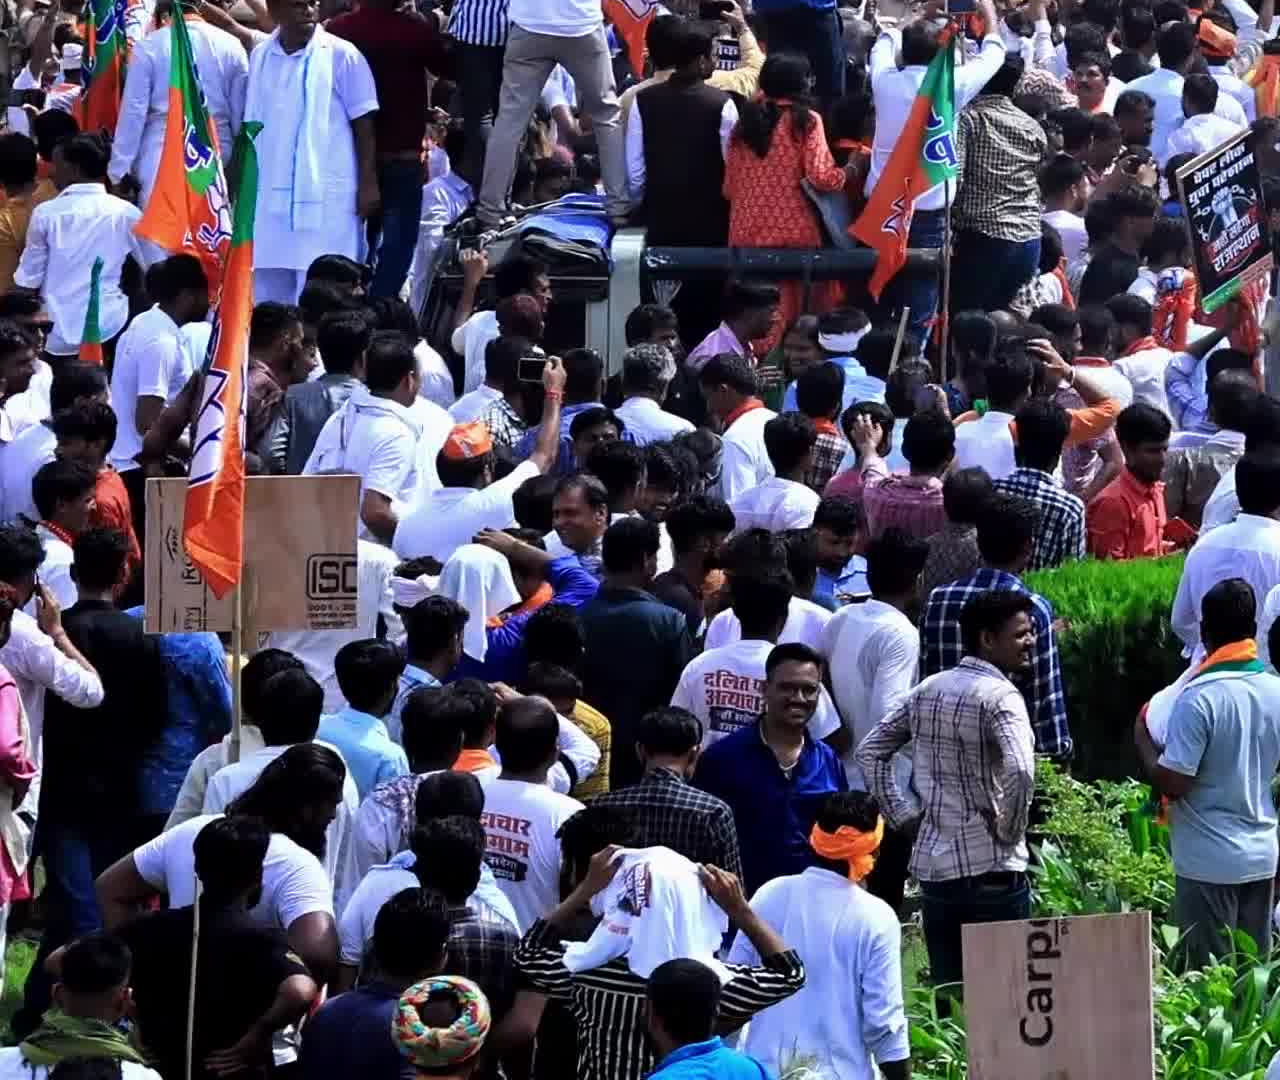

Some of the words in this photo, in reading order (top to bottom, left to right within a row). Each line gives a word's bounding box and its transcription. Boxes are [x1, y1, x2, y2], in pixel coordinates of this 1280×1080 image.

[1194, 164, 1217, 184] पेपर
[1219, 141, 1246, 169] लीक
[1188, 183, 1210, 208] युवा
[1213, 224, 1260, 273] राजस्थान
[704, 670, 749, 692] दलित
[705, 689, 760, 713] अत्याचा
[486, 833, 529, 858] गाम
